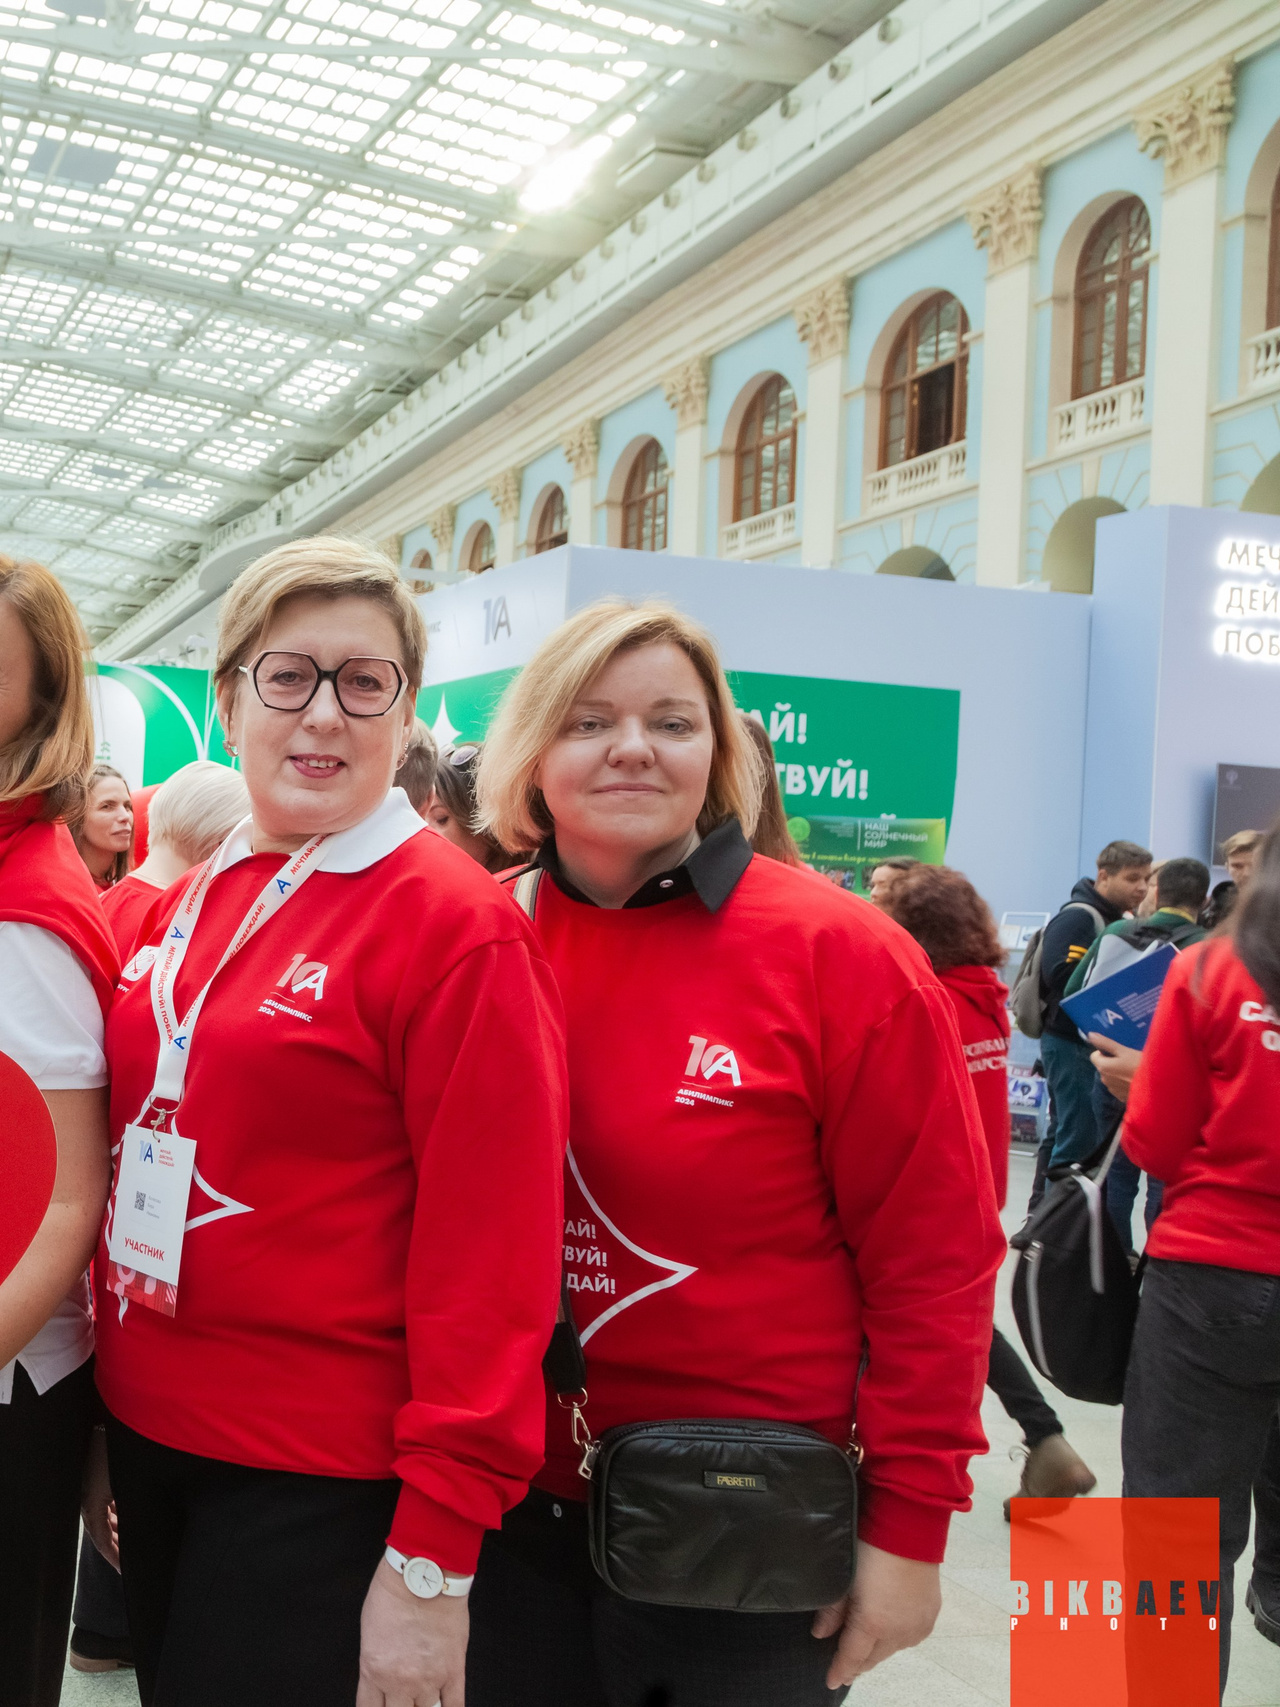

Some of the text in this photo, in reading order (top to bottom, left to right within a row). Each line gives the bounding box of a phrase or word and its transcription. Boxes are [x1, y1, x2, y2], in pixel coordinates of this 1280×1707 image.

[257, 1006, 276, 1017] 2024
[262, 998, 313, 1023] АБИЛИМПИКС
[674, 1096, 695, 1106] 2024
[677, 1088, 735, 1107] АБИЛИМПИКС
[564, 1218, 597, 1239] АЙ!
[124, 1237, 165, 1262] УЧАСТНИК
[562, 1245, 608, 1267] ВУЙ!
